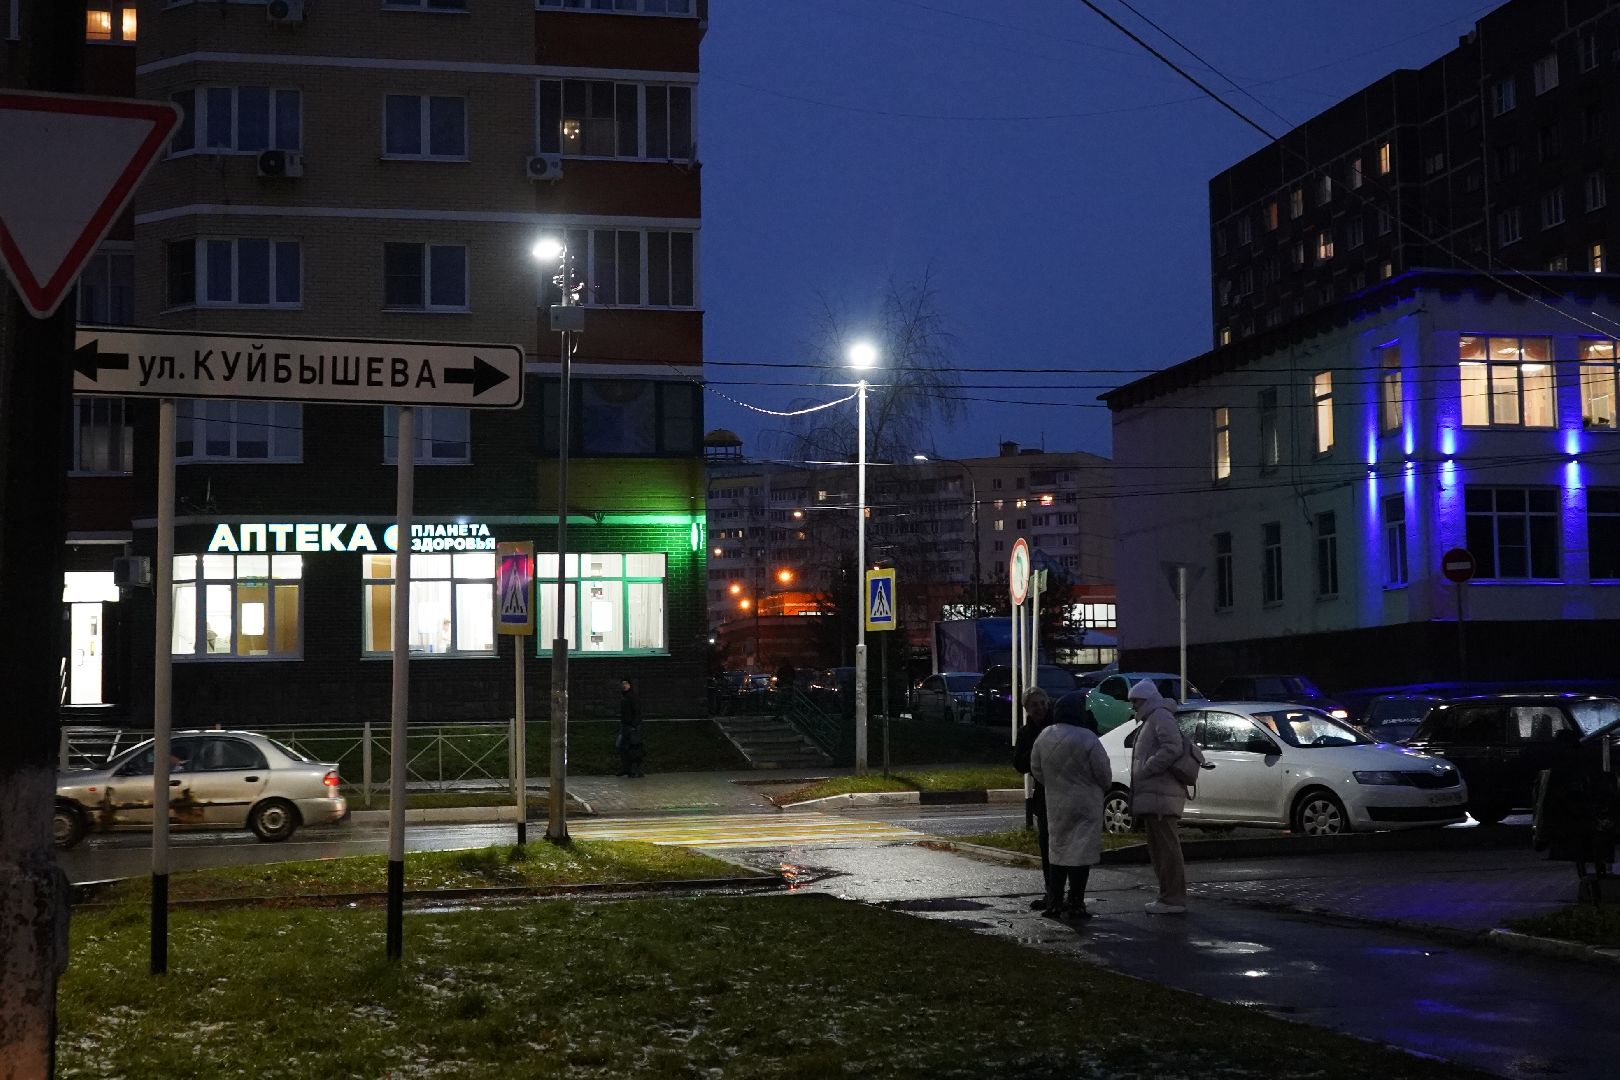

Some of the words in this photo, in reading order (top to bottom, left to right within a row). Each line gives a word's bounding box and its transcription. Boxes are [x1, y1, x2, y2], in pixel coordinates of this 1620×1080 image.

[138, 355, 185, 386] ул.
[194, 344, 436, 388] КУЙБЫШЕВА
[208, 524, 378, 551] АПТЕКА
[411, 525, 490, 537] ПЛАНЕТА
[411, 538, 496, 552] ЗДОРОВЬЯ
